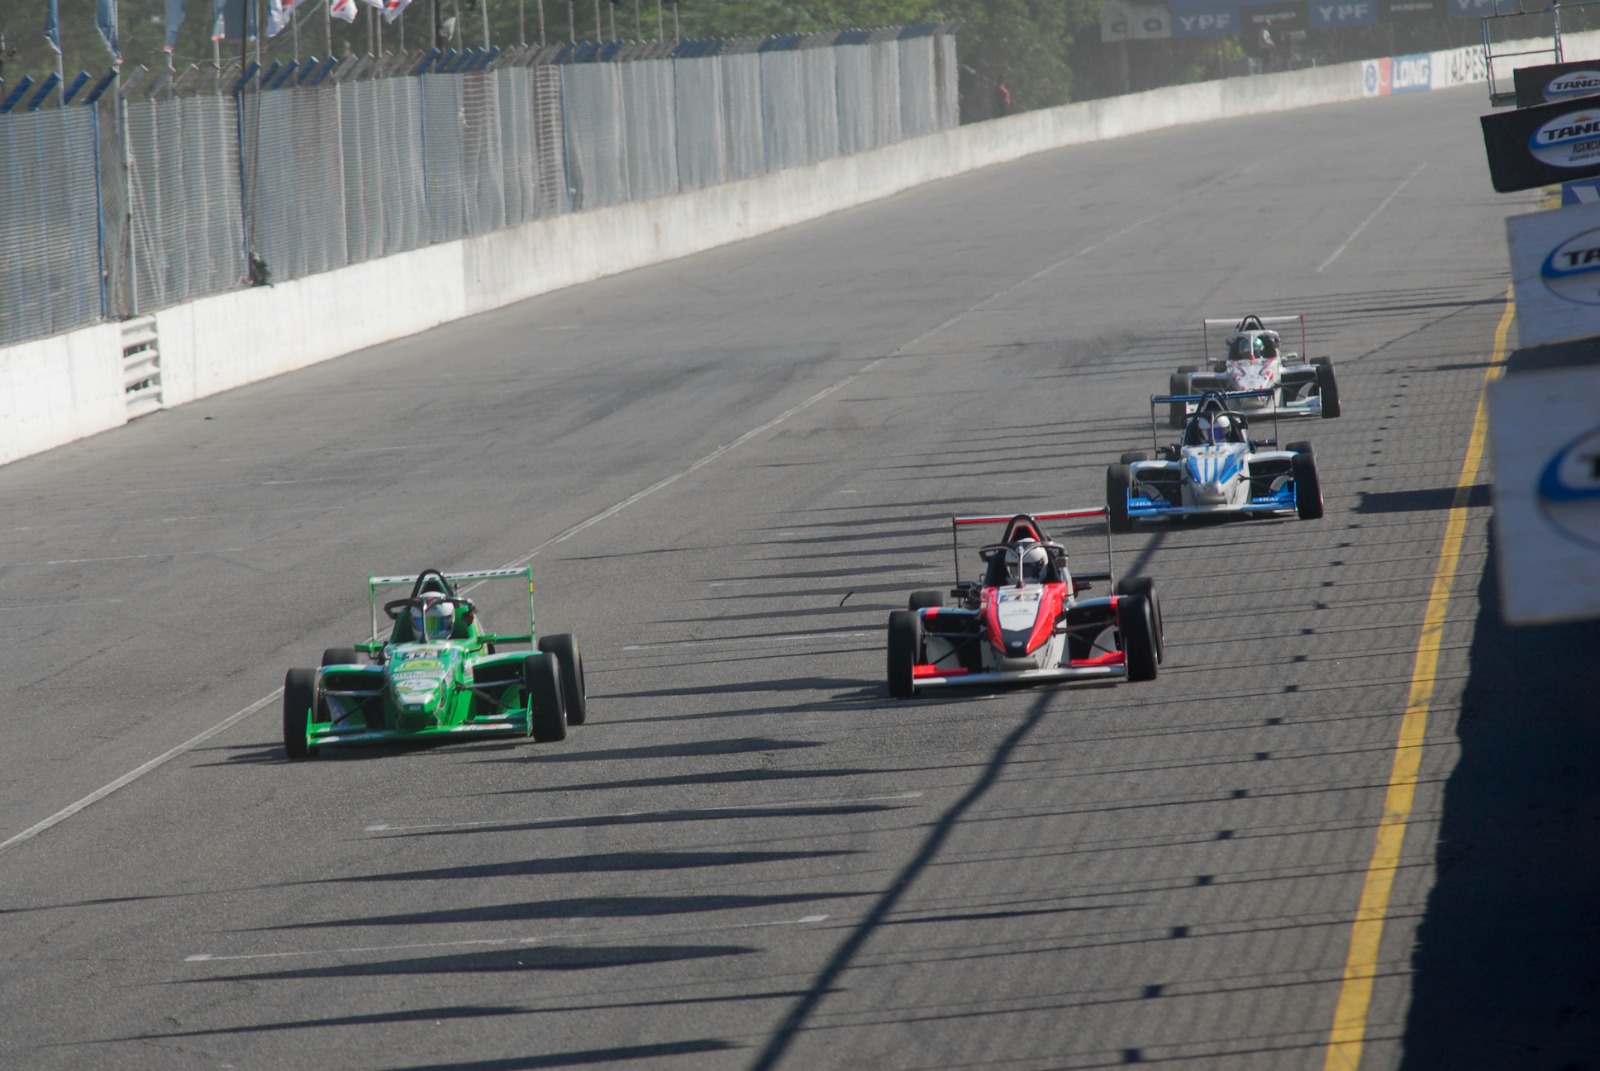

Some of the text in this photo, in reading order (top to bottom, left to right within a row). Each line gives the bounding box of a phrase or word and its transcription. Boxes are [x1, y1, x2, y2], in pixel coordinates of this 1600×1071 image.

[1180, 13, 1231, 31] YPF
[1317, 3, 1369, 22] YPF
[1392, 58, 1430, 89] LONG
